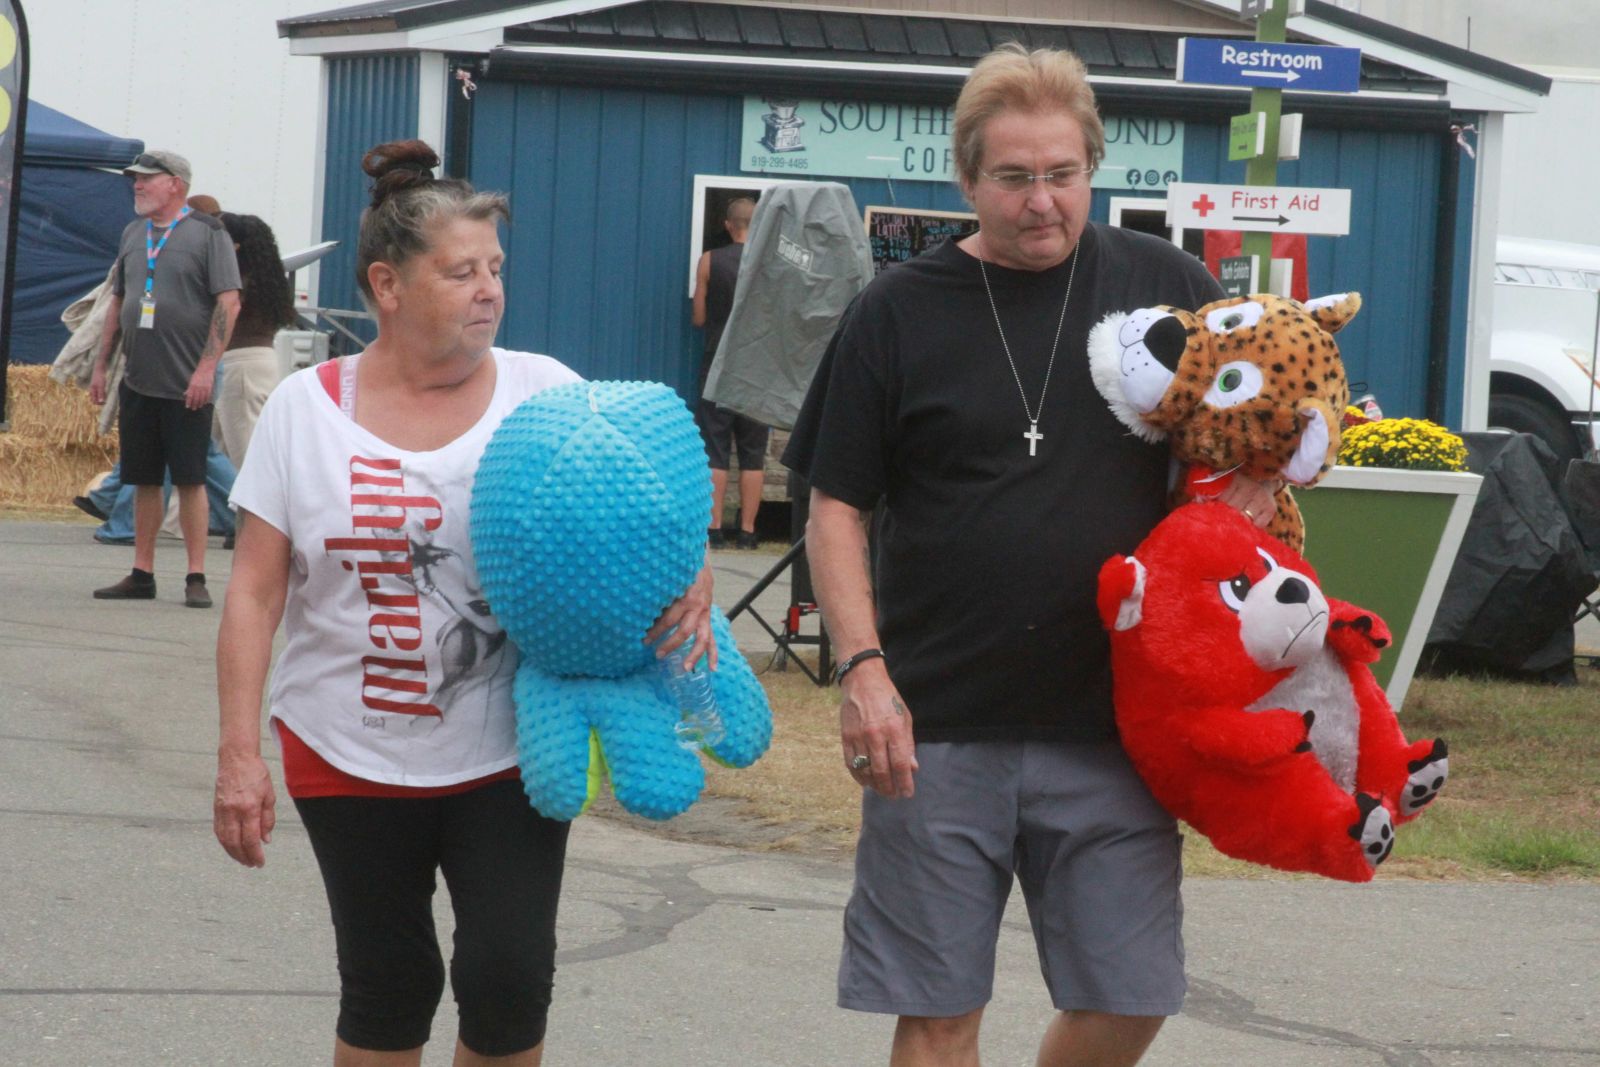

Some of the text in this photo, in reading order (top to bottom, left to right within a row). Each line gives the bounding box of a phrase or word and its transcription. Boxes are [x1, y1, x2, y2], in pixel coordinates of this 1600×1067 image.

[1222, 45, 1322, 71] Restroom
[1104, 117, 1176, 146] UND
[904, 146, 953, 174] COF
[1232, 191, 1320, 211] First Aid
